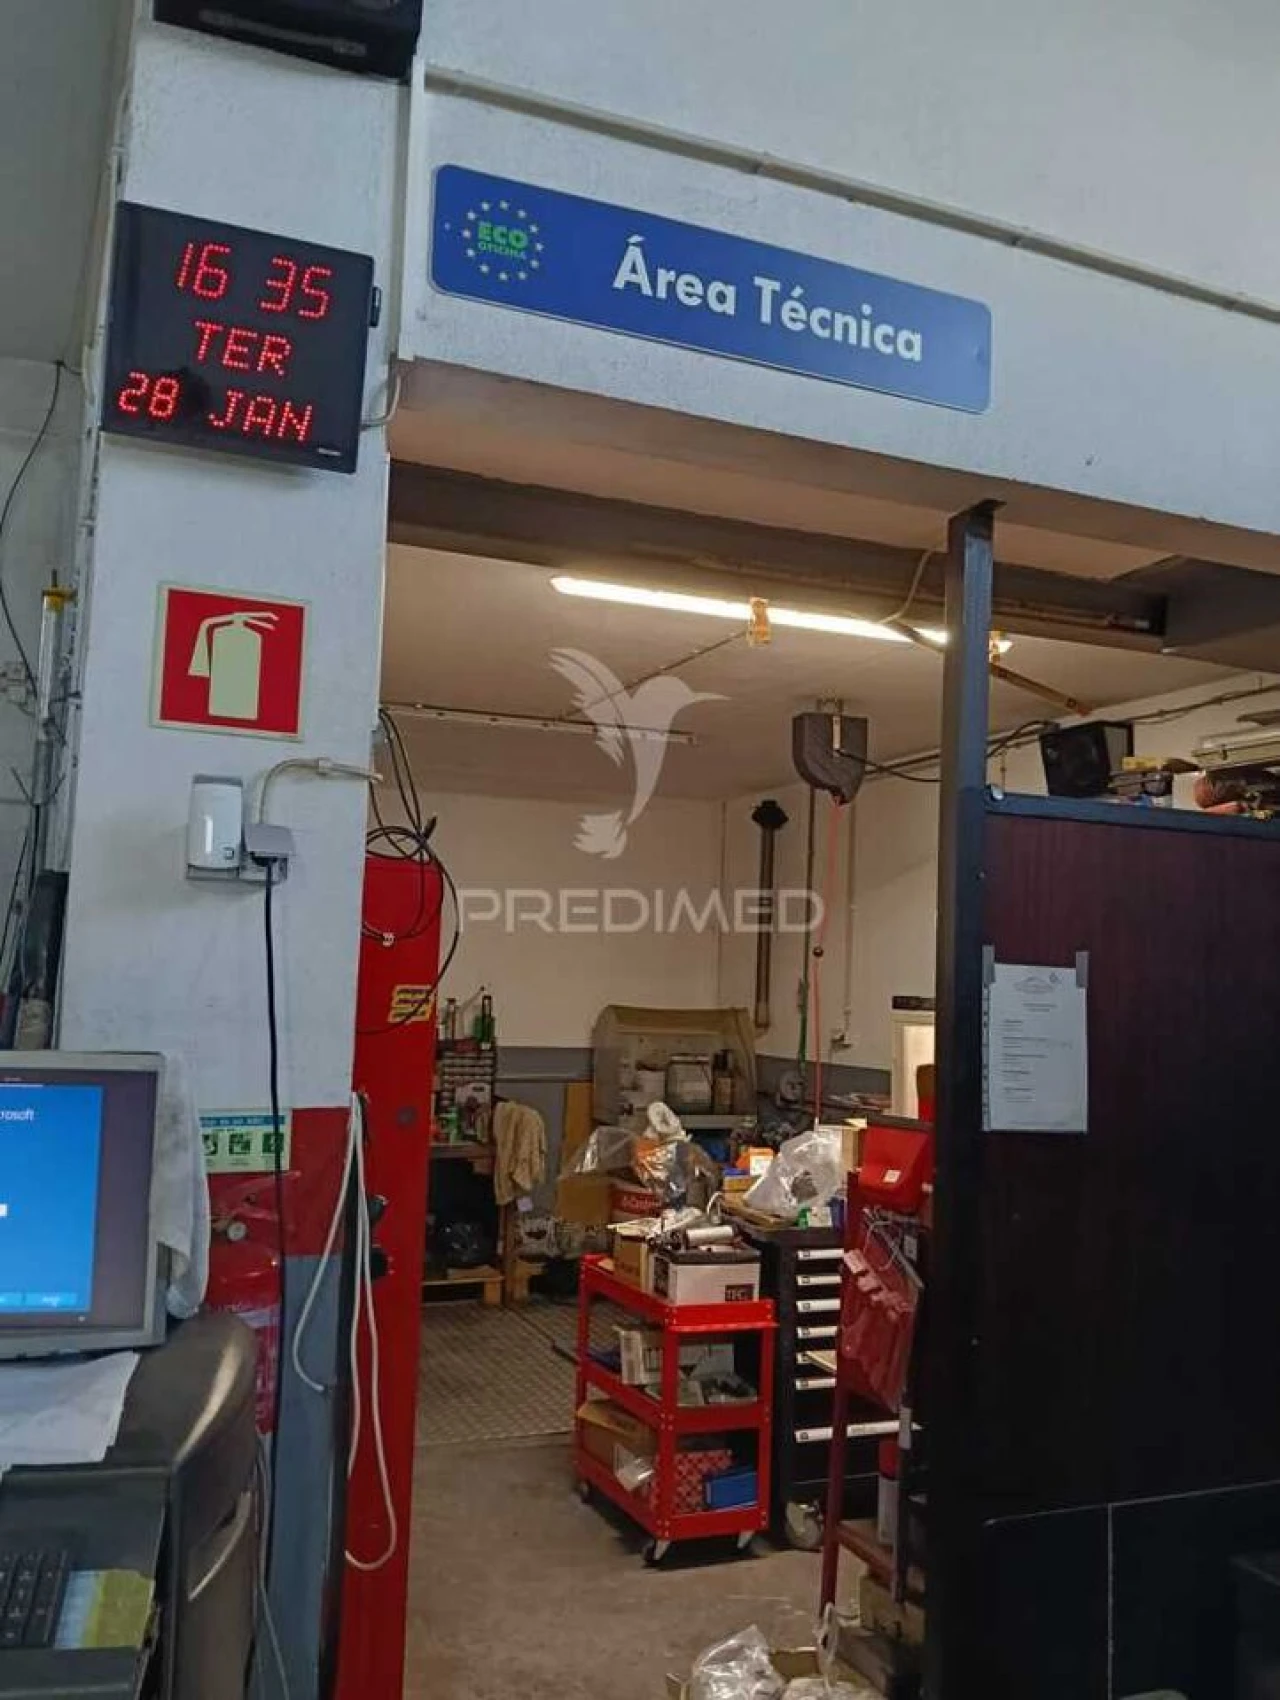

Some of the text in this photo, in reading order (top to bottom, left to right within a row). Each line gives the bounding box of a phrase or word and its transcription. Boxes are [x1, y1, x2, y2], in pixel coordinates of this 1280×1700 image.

[478, 221, 528, 249] ECO
[176, 242, 333, 319] 16 35
[612, 234, 923, 362] Área Técnica
[194, 319, 292, 377] TER
[117, 371, 314, 442] 28 JAN
